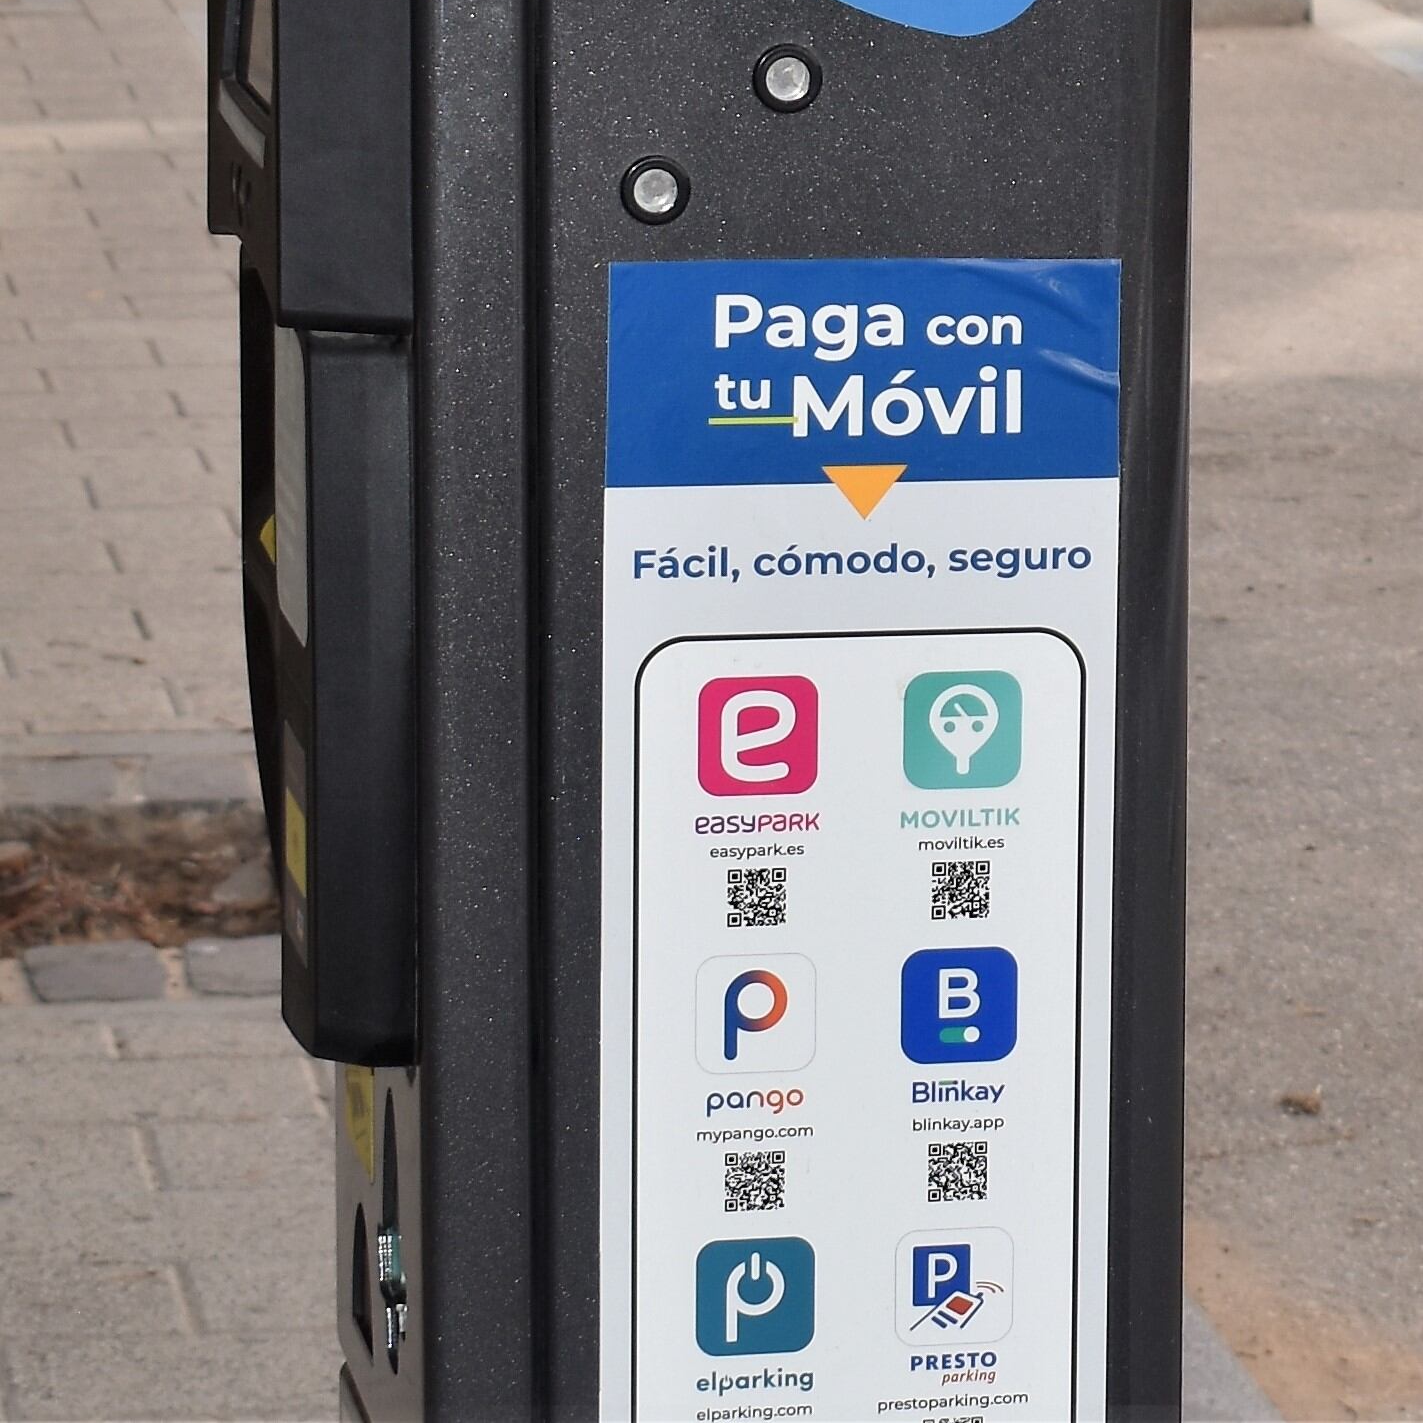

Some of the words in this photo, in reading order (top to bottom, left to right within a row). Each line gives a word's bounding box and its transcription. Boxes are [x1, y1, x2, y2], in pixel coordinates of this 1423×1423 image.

[714, 294, 904, 362] Paga
[926, 315, 1022, 346] con
[714, 373, 771, 410] tu
[792, 365, 1022, 438] Móvil
[633, 545, 740, 584] Fácil,
[753, 542, 936, 579] cómodo,
[948, 546, 1092, 579] seguro
[900, 807, 1020, 829] MOVILTIK
[709, 842, 805, 861] easypark.es
[918, 836, 1005, 851] moviltik.es
[938, 968, 981, 1019] B
[912, 1079, 1006, 1104] Blinkay
[706, 1088, 804, 1118] pango
[696, 1126, 814, 1144] mypango.com
[912, 1117, 1005, 1133] blinkay.app
[927, 1252, 958, 1299] P
[910, 1351, 997, 1372] PRESTO
[696, 1367, 814, 1397] elparking
[941, 1366, 997, 1387] parking
[696, 1405, 813, 1423] elparking.com
[877, 1393, 1029, 1415] prestoparking.com
